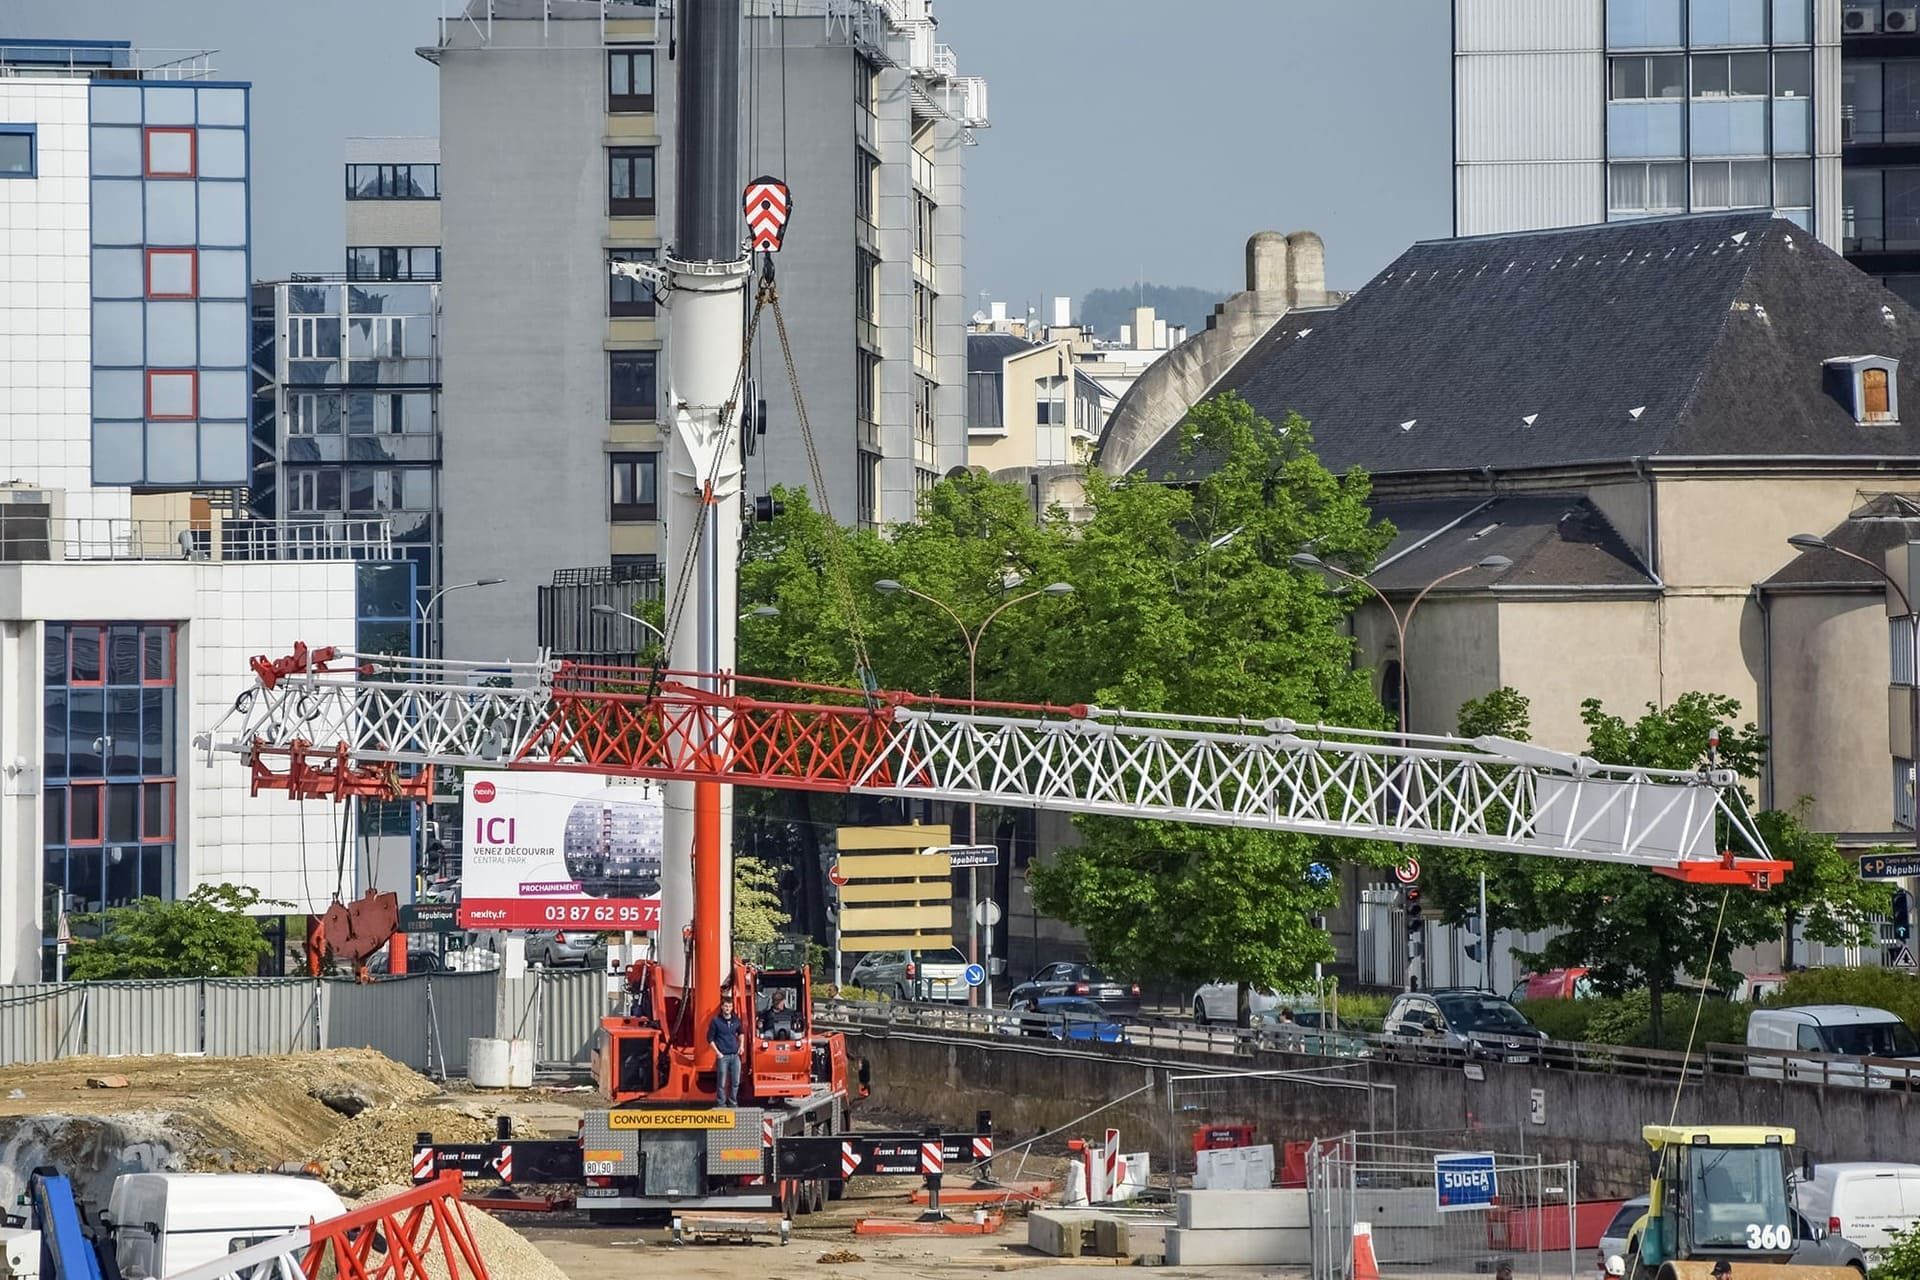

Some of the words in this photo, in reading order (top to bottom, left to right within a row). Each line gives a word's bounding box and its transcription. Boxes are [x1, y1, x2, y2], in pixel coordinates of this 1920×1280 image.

[476, 817, 515, 844] ICI
[473, 847, 502, 855] VENEZ
[504, 845, 555, 855] DÉCOUVRIR
[473, 856, 505, 864] CENTRAL
[507, 856, 527, 864] PARK
[521, 883, 580, 893] PROCHAINEMENT
[470, 910, 507, 920] nexity.fr
[545, 906, 566, 921] 03
[570, 906, 590, 921] 87
[594, 906, 614, 921] 62
[619, 906, 639, 921] 95
[614, 1115, 653, 1125] CONVOI
[654, 1114, 730, 1124] EXCEPTIONNEL
[586, 1162, 597, 1174] 80
[601, 1162, 612, 1174] 90
[1444, 1169, 1489, 1189] SOGEA
[1746, 1223, 1791, 1249] 360
